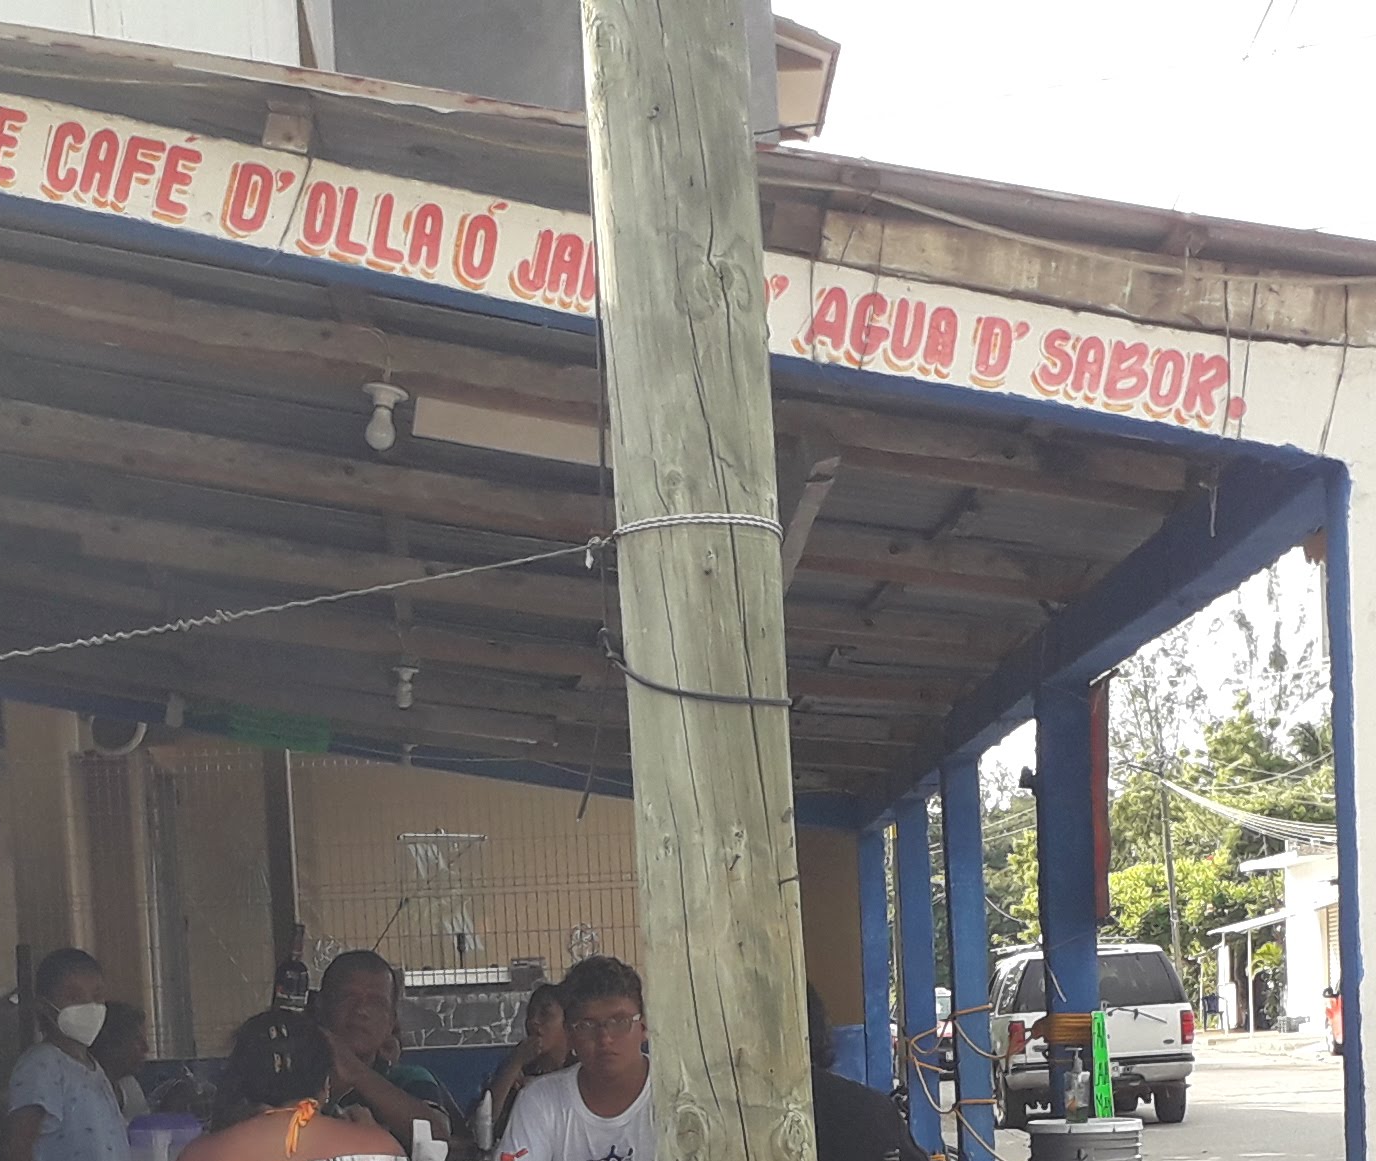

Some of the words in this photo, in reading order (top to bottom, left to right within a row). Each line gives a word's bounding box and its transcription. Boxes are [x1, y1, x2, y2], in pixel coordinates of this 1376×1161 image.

[42, 117, 203, 223] CAFÉ
[224, 162, 297, 238] D'
[298, 180, 444, 275] OLLA
[455, 200, 508, 292] Ó
[795, 284, 957, 380] AGUA
[970, 317, 1030, 390] D'
[1033, 327, 1246, 429] SABOR.
